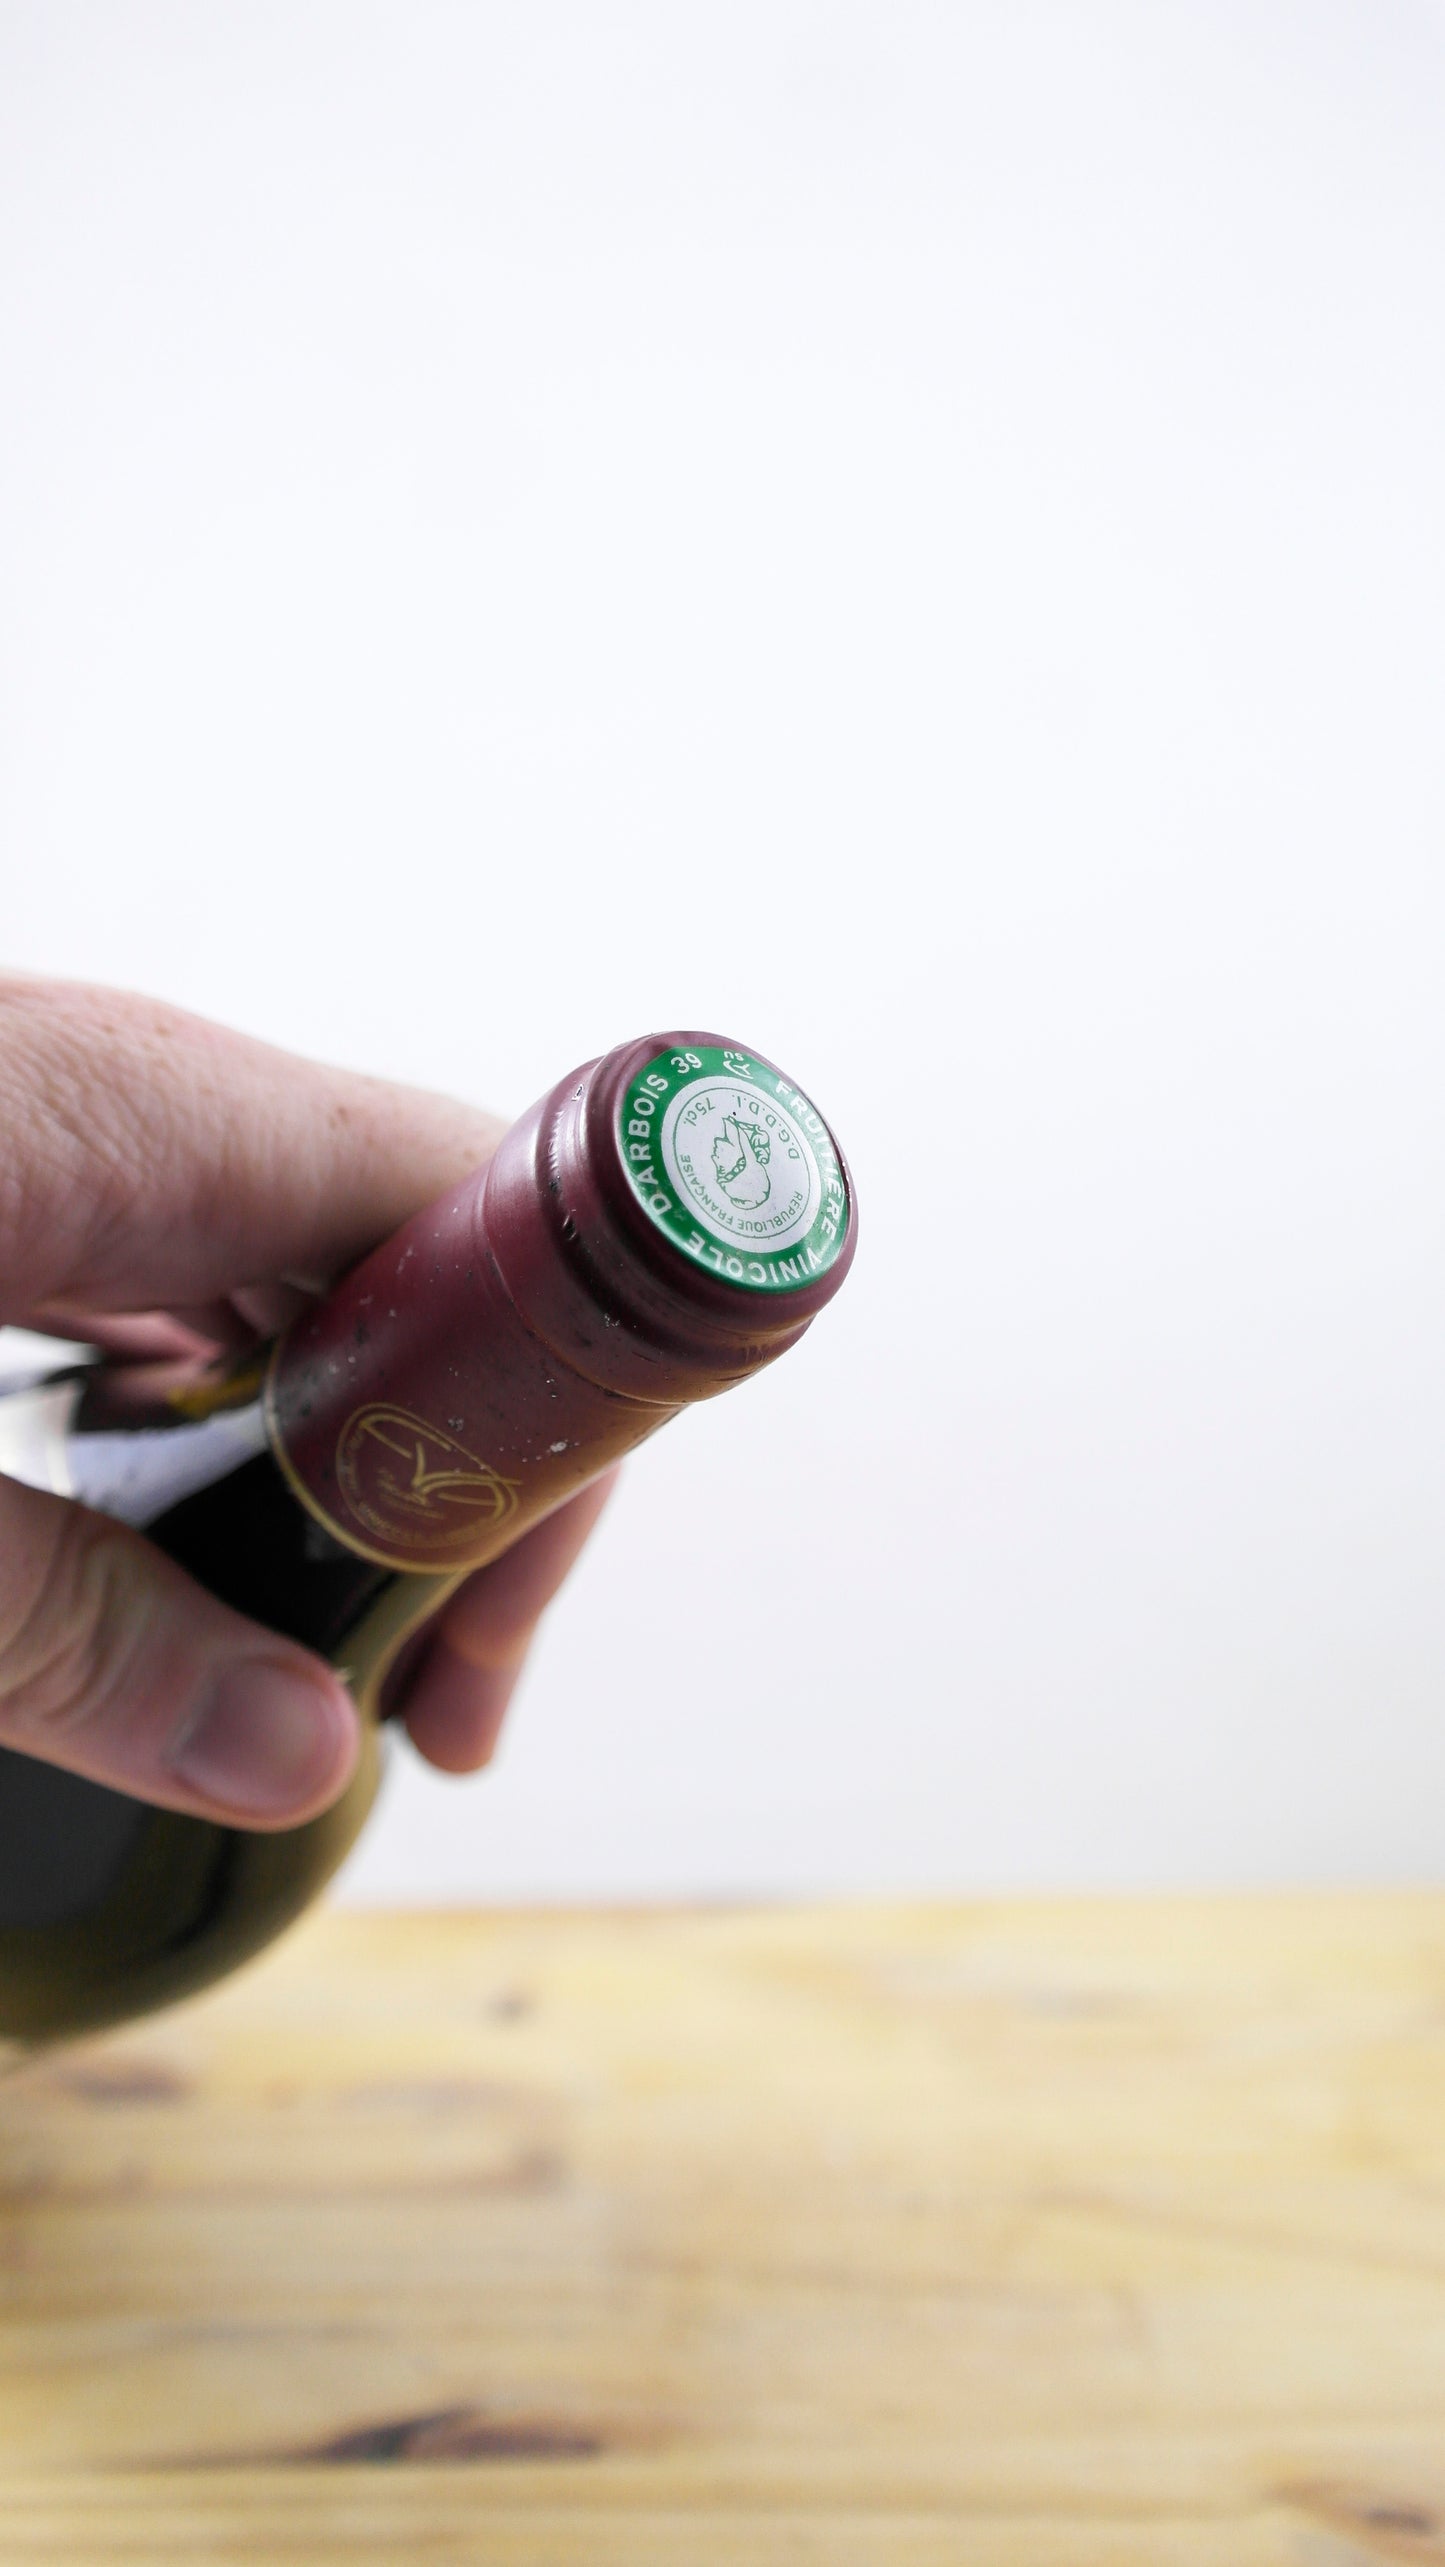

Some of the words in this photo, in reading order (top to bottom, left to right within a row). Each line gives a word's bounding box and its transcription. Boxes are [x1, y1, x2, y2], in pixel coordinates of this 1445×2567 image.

[671, 1052, 702, 1074] 39
[680, 1153, 734, 1227] FRANÇAISE
[685, 1231, 822, 1284] VINICOLE
